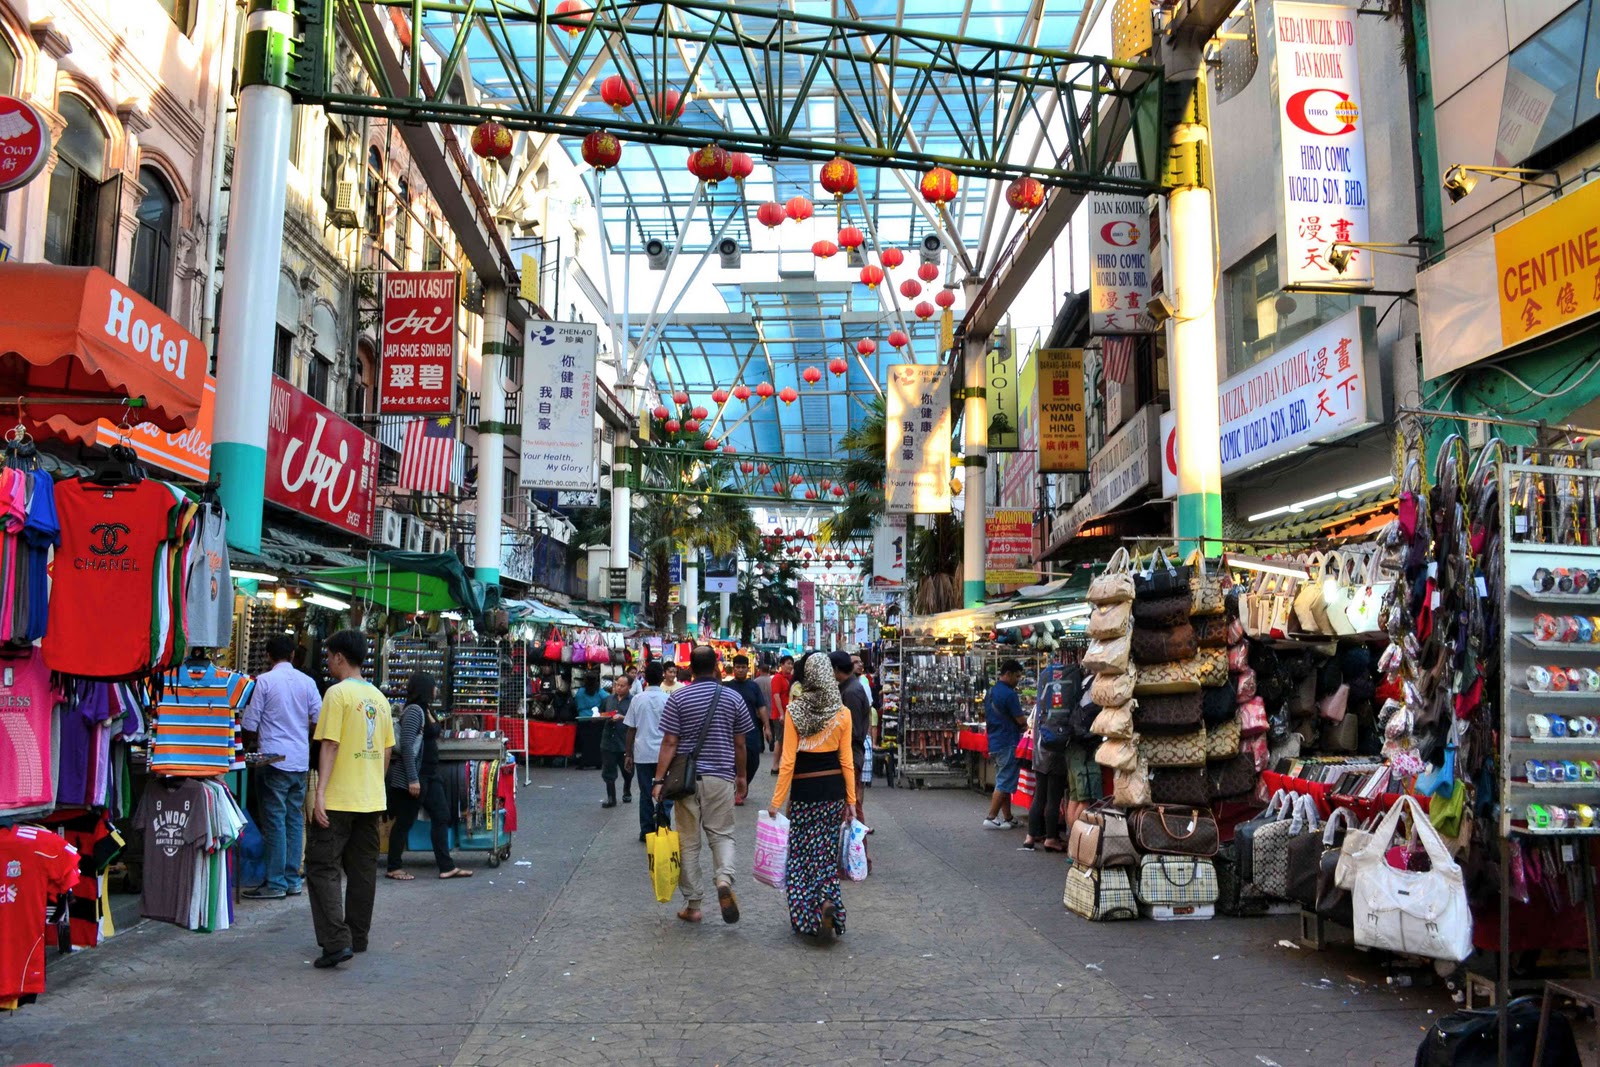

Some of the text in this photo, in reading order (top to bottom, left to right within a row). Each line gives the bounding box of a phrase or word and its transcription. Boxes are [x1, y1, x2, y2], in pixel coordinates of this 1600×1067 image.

[1279, 16, 1304, 43] KEDAI
[1336, 20, 1354, 46] DVD
[1295, 51, 1343, 78] DAN KOMIK
[1300, 145, 1351, 173] HIRO COMIC
[1117, 165, 1140, 178] MUZI
[1289, 176, 1365, 206] WORLD SDN. BHD.
[1094, 201, 1146, 214] DAN KOMIK
[1097, 254, 1145, 269] HIRO COMIC
[1096, 271, 1117, 286] WORLD
[387, 280, 453, 298] KEDAI KASUT
[104, 289, 189, 380] Hotel
[559, 328, 592, 336] ZHEN-AO
[384, 344, 451, 357] JAPI SHOE SDN BHD
[560, 355, 575, 399] 你健康
[1282, 349, 1310, 395] KOMIK
[1314, 374, 1358, 423] 天下
[270, 384, 291, 434] KASUT
[538, 386, 552, 430] 我自豪
[1042, 404, 1082, 412] KWONG
[1050, 413, 1074, 421] NAM
[1049, 424, 1075, 432] HING
[1219, 434, 1242, 464] COMIC
[1244, 416, 1269, 454] WORLD
[543, 453, 573, 462] Health,
[546, 464, 558, 472] My
[561, 464, 583, 473] Glory
[522, 479, 590, 489] www.zhen-ao.com.my
[346, 510, 360, 528] SHOES
[995, 511, 1032, 525] PROMOTION
[74, 557, 141, 571] CHANEL
